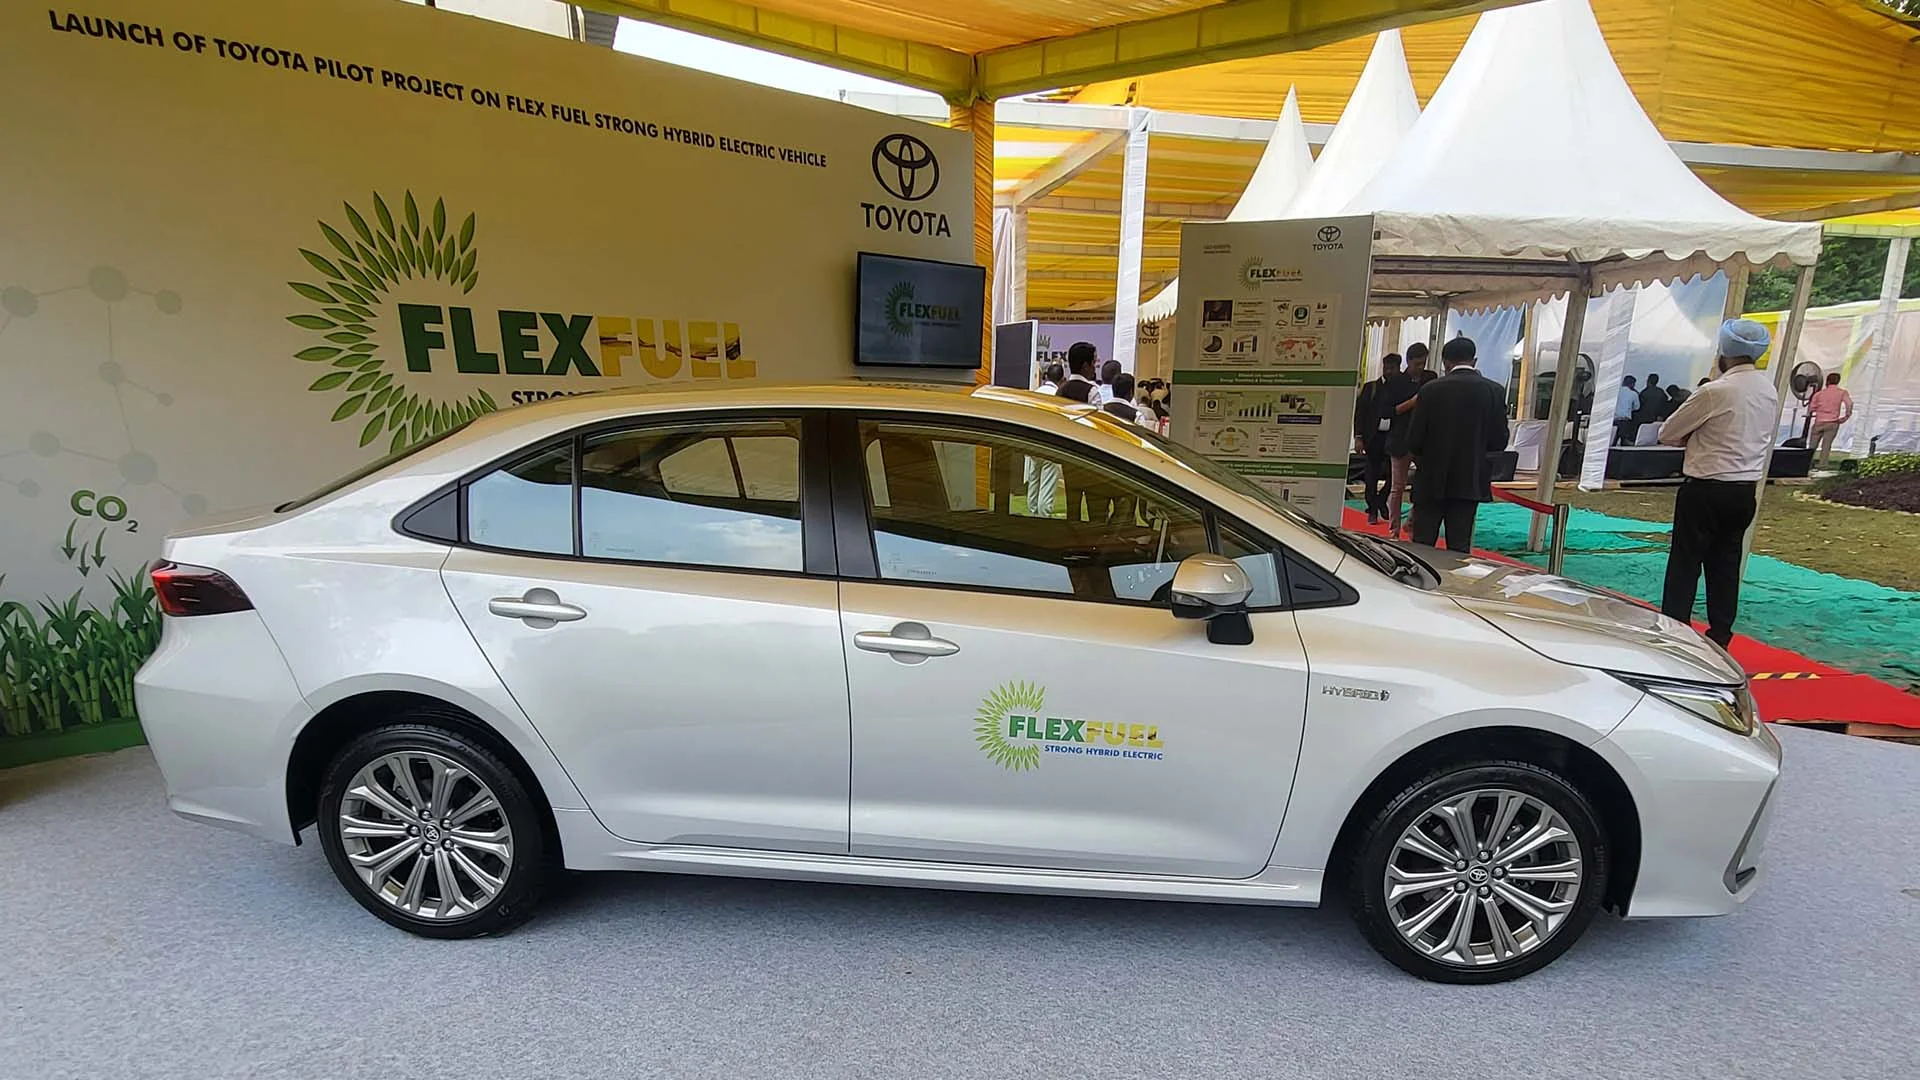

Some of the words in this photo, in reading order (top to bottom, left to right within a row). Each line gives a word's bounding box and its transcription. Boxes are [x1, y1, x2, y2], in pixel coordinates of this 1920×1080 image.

[48, 10, 164, 47] LAUNCH
[173, 31, 207, 54] OF
[213, 37, 308, 72] TOYOTA
[314, 56, 375, 85] PILOT
[381, 69, 464, 102] PROJECT
[471, 87, 501, 109] ON
[506, 95, 547, 118] FLEX
[551, 104, 591, 127] FUEL
[595, 113, 659, 139] STRONG
[663, 126, 715, 149] HYBRID
[719, 137, 776, 160] ELECTRIC
[778, 148, 827, 168] VEHICLE
[861, 203, 951, 237] TOYOTA
[1312, 242, 1344, 251] TOYOTA
[1044, 744, 1083, 755] STRONG
[1085, 747, 1120, 757] HYBRID
[1122, 750, 1163, 760] ELECTRIC
